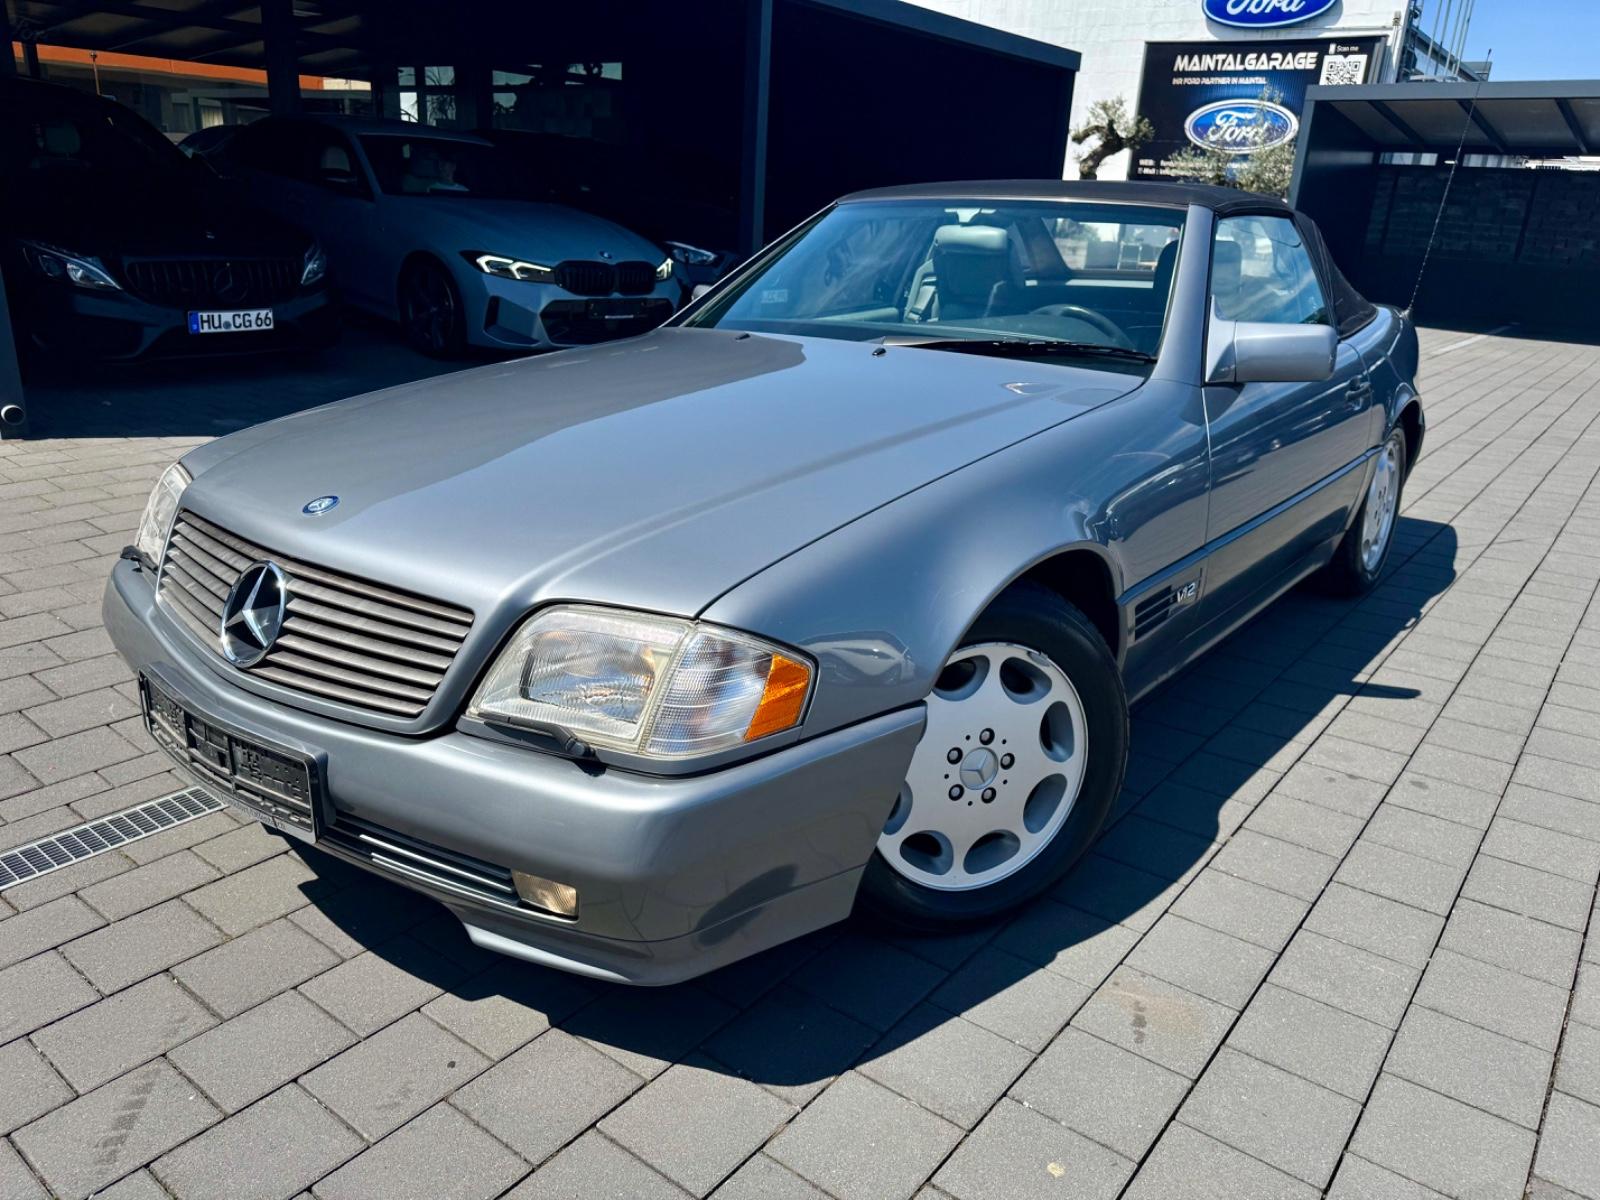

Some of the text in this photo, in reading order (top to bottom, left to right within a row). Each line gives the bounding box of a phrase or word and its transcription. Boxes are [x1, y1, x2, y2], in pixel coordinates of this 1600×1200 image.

[1173, 51, 1319, 72] MAINTALGARAGE
[1184, 77, 1200, 85] FORD
[1201, 77, 1230, 85] PARTNER
[1206, 110, 1269, 142] Ford
[200, 312, 272, 330] HU CG 66
[1177, 582, 1196, 603] V12
